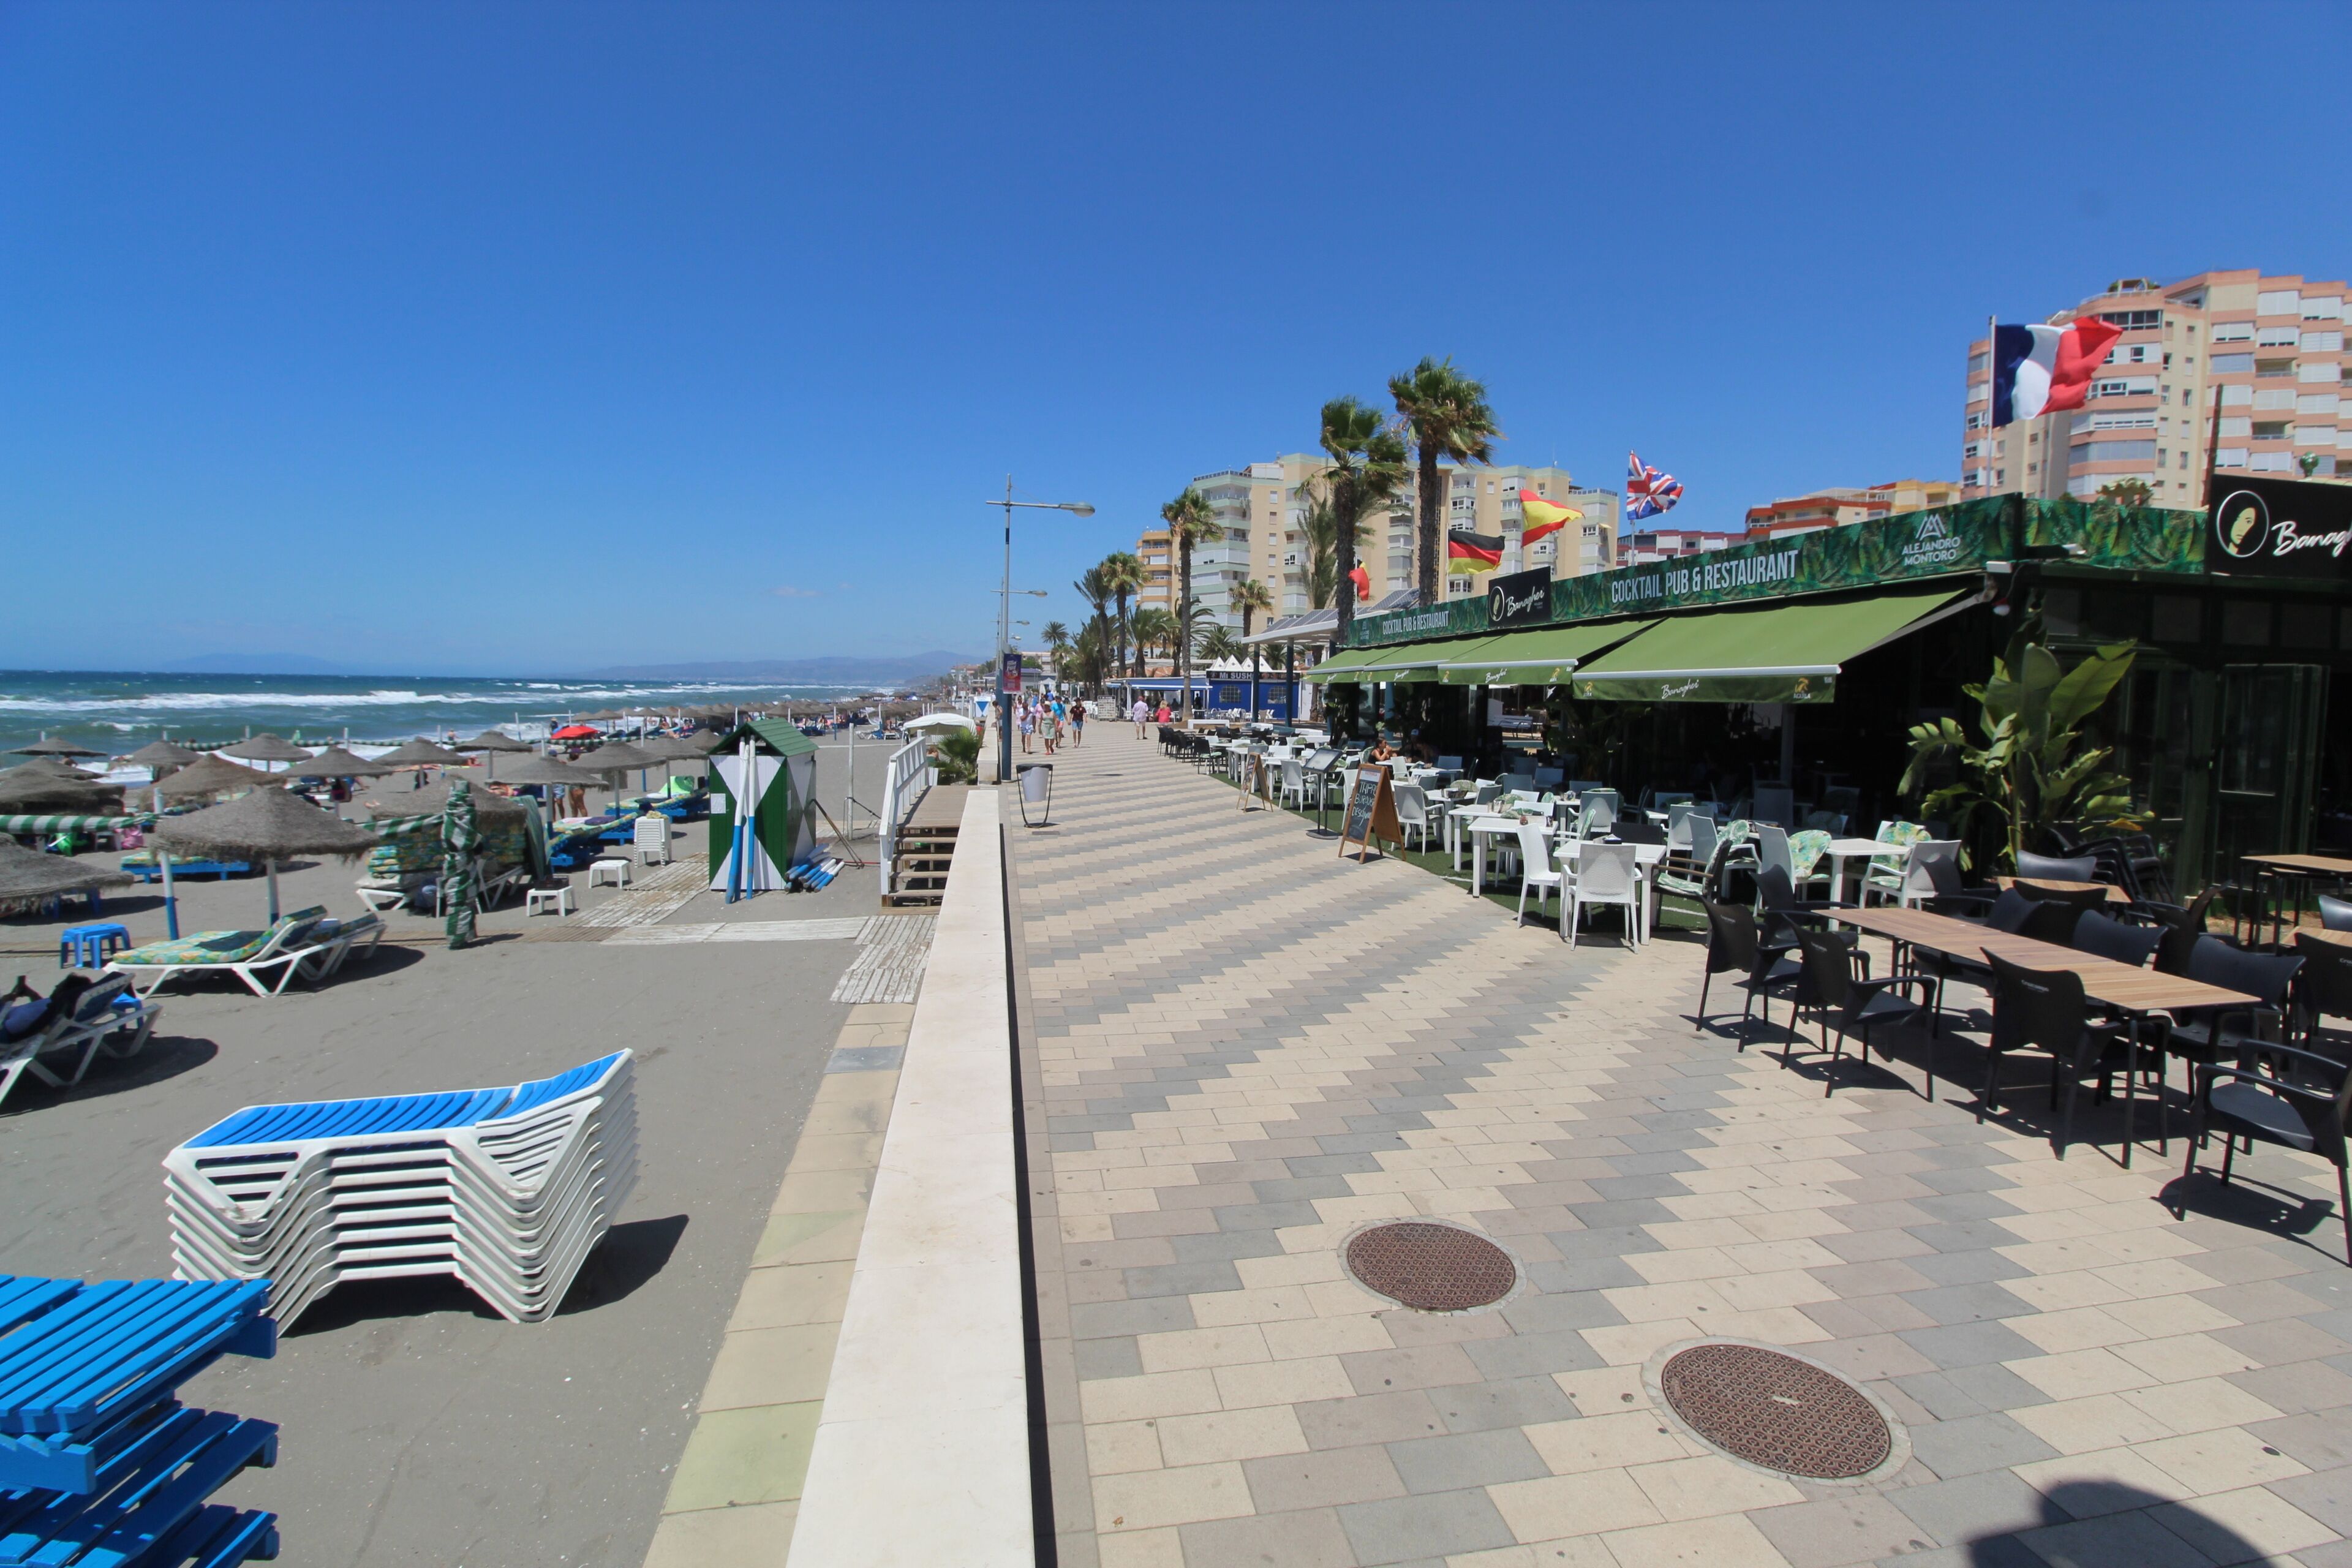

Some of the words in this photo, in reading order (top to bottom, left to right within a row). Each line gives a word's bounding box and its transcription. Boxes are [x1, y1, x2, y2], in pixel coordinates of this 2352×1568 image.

[1902, 537, 1961, 555] ALEJANDRO
[2271, 521, 2352, 557] Banag
[1904, 549, 1956, 566] MONTORO
[1611, 574, 1662, 603] COCKTAIL
[1665, 569, 1689, 596] PUB
[1692, 567, 1701, 592] &
[1705, 549, 1799, 591] RESTAURANT
[1506, 586, 1545, 617] Banagher
[1382, 616, 1403, 635] COCKTAIL
[1403, 614, 1412, 631] PUB
[1413, 612, 1417, 630] &
[1417, 611, 1449, 630] RESTAURANT
